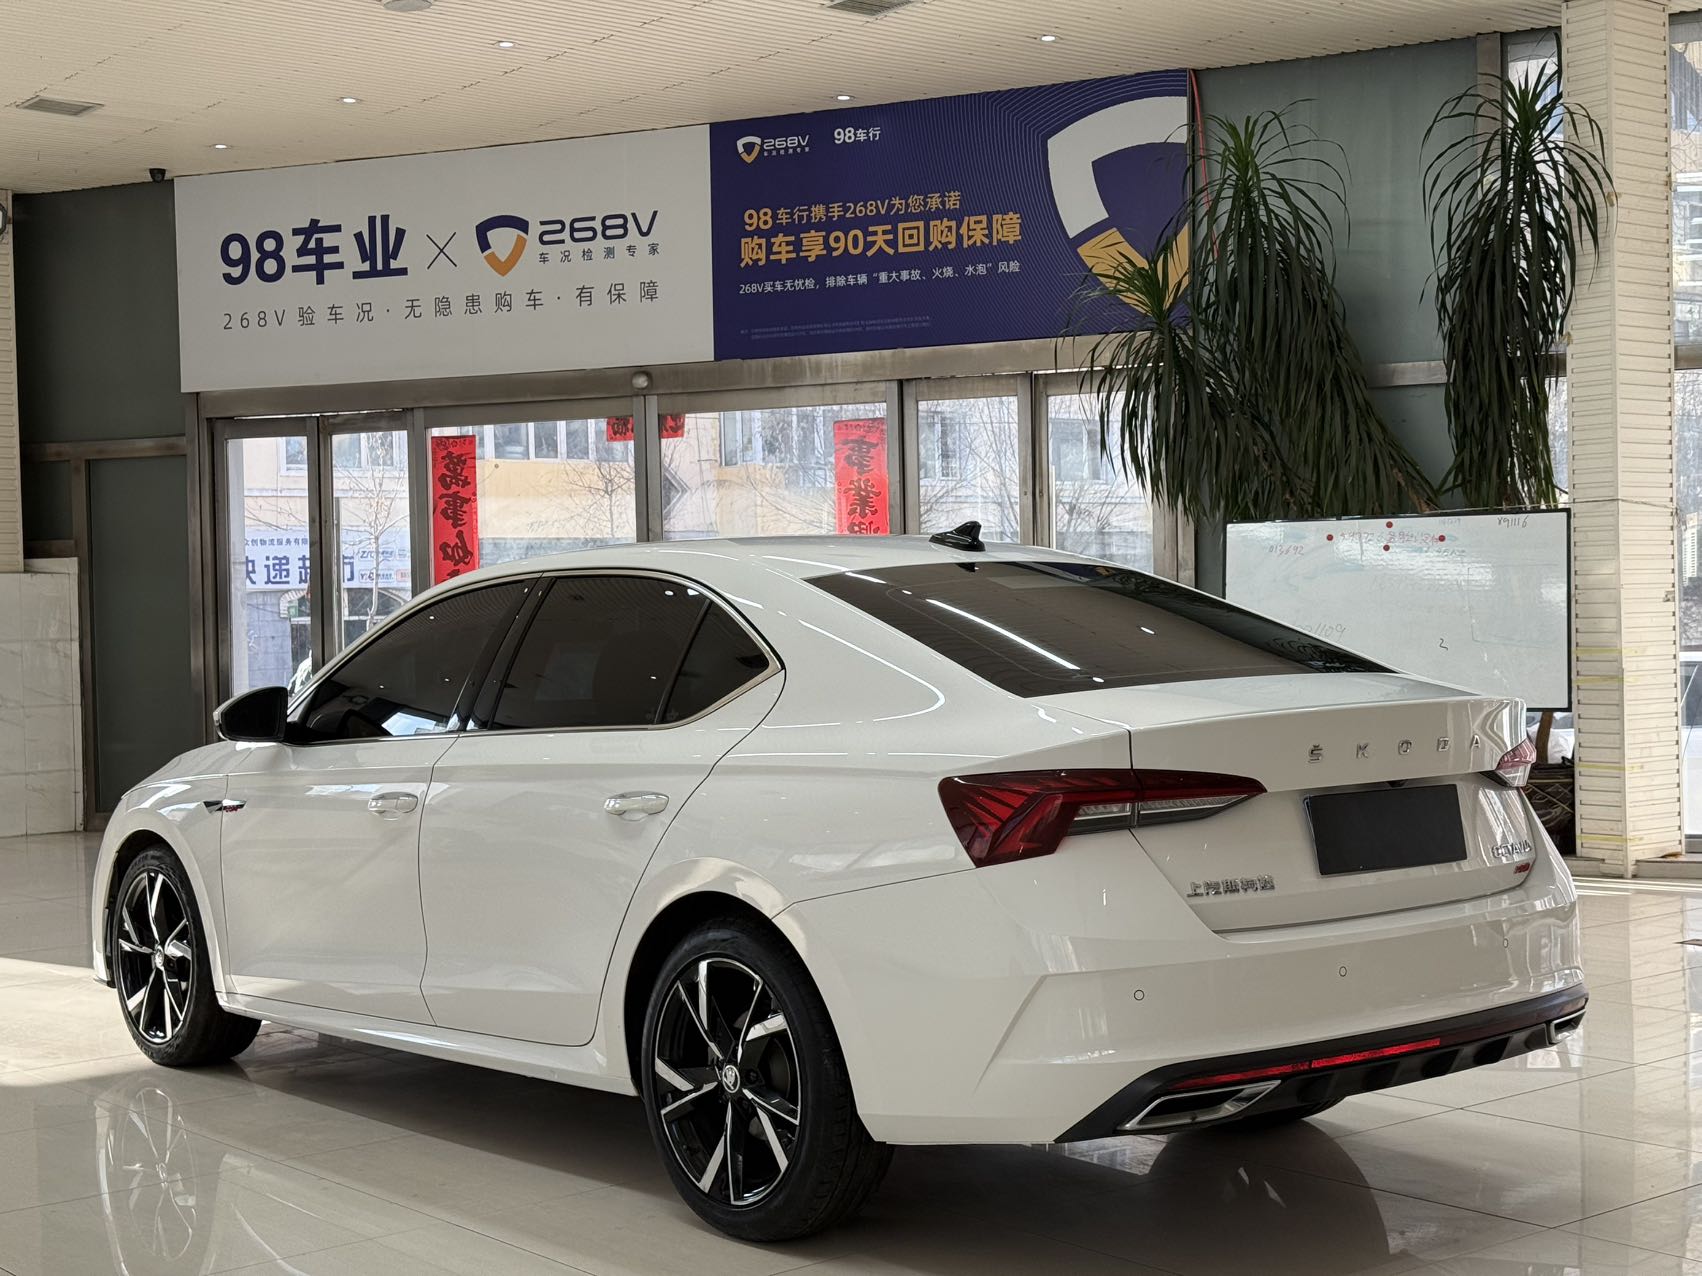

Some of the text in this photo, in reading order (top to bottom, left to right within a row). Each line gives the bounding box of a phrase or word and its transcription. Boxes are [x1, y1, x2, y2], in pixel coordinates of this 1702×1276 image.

[763, 135, 810, 150] 268V
[834, 126, 881, 144] 98车行
[538, 210, 658, 245] 268V
[739, 211, 1022, 269] 购车享90天回购保障
[220, 214, 409, 286] 98车业
[538, 242, 660, 265] 车况检测专家
